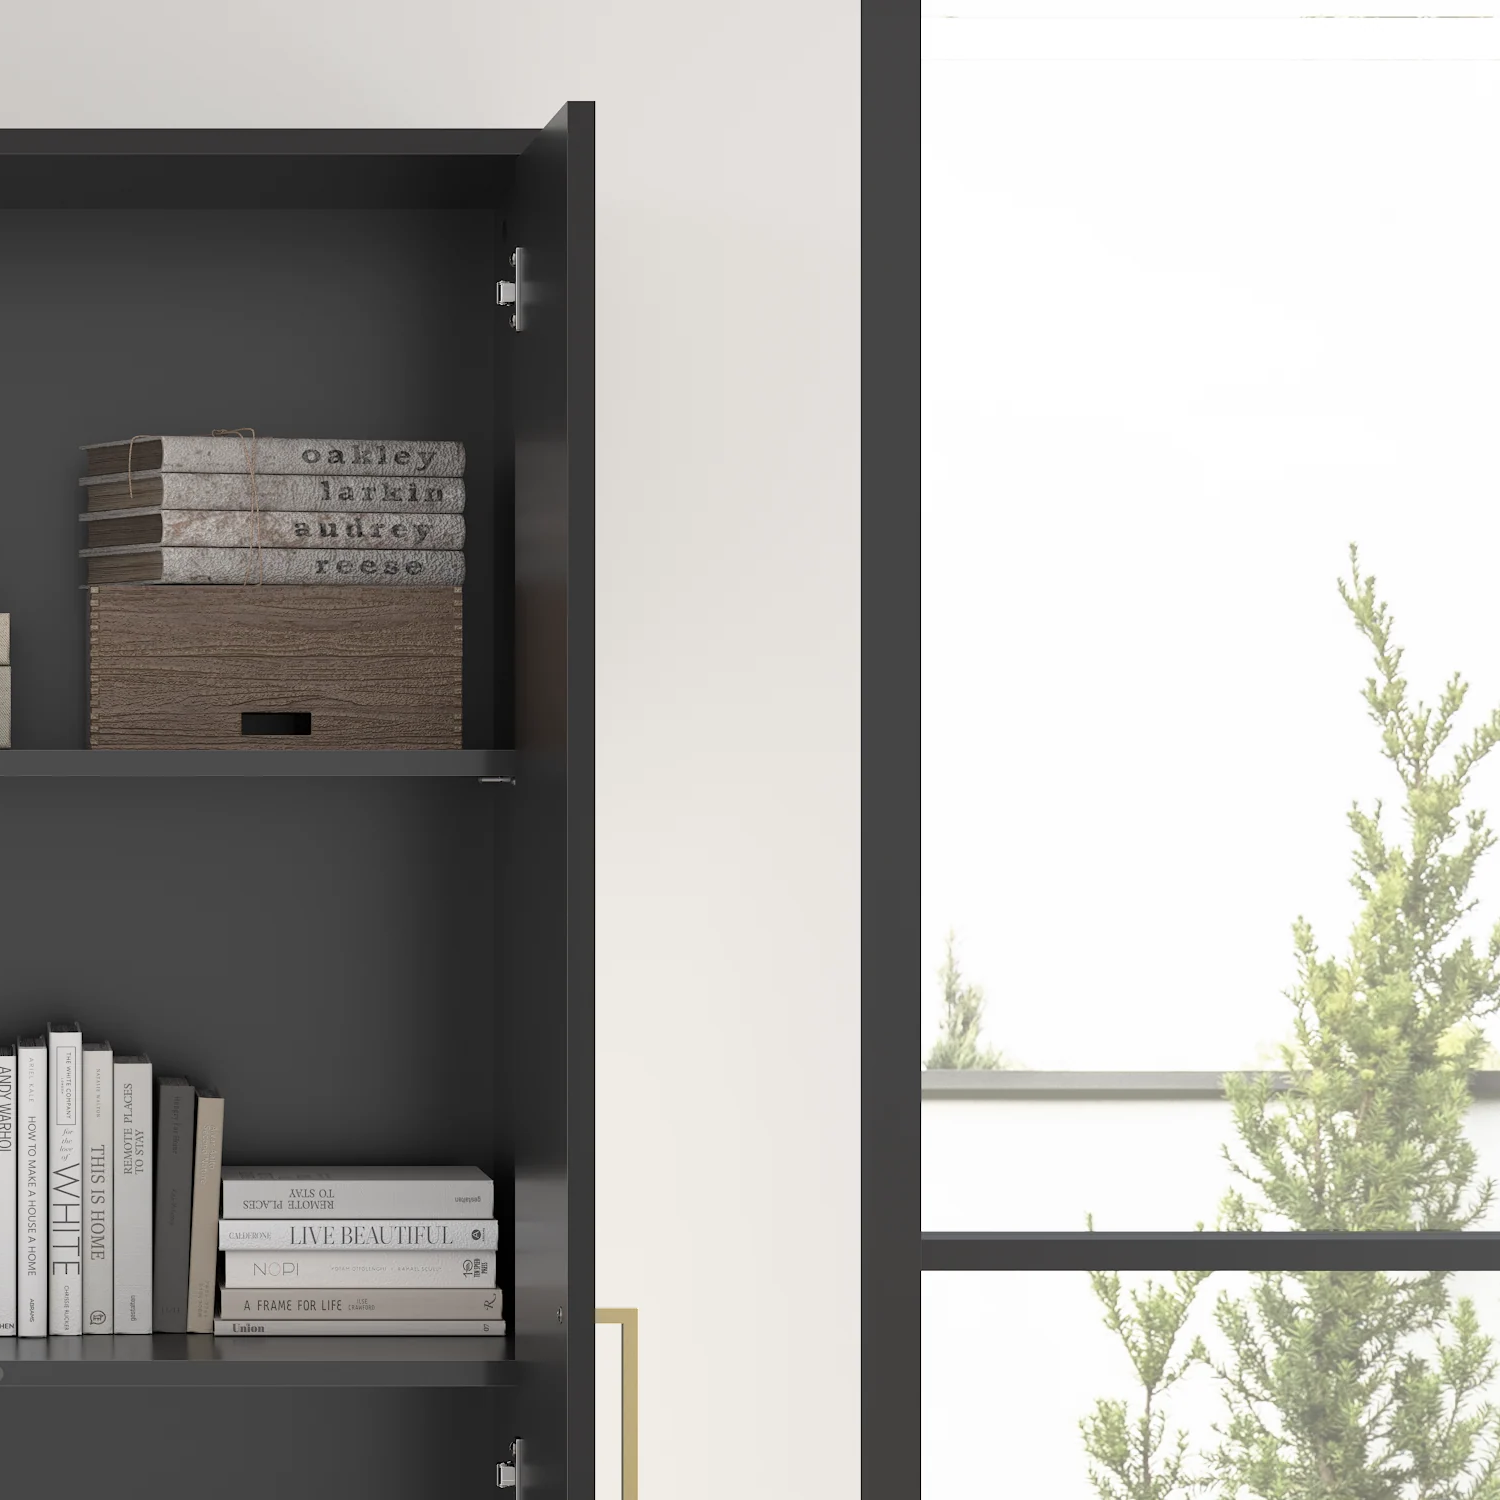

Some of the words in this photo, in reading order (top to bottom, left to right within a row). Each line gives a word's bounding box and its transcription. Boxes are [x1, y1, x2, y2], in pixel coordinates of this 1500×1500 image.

[301, 444, 438, 471] oakley
[319, 480, 444, 502] larkin
[294, 519, 435, 544] audrey
[314, 557, 424, 576] reese
[123, 1083, 133, 1124] PLACES
[28, 1116, 37, 1142] HOW
[28, 1144, 37, 1157] TO
[123, 1128, 133, 1175] REMOTE
[134, 1129, 144, 1155] STAY
[28, 1160, 37, 1187] MAKE
[91, 1145, 105, 1184] THIS
[134, 1156, 144, 1175] TO
[91, 1189, 105, 1204] IS
[289, 1189, 316, 1198] STAY
[318, 1189, 335, 1198] TO
[243, 1200, 283, 1210] PLACES
[288, 1200, 335, 1210] REMOTE
[28, 1200, 37, 1234] HOUSE
[52, 1163, 80, 1275] WHITE
[28, 1236, 37, 1244] A
[91, 1210, 105, 1260] HOME
[229, 1232, 272, 1240] CALDERONE
[290, 1226, 335, 1245] LIVE
[341, 1226, 453, 1245] BEAUTIFUL
[28, 1247, 37, 1276] HOME
[253, 1262, 299, 1276] NOPI
[244, 1298, 250, 1311] A
[257, 1298, 292, 1311] FRAME
[297, 1298, 317, 1311] FOR
[322, 1298, 342, 1311] LIFE
[232, 1323, 265, 1333] Union
